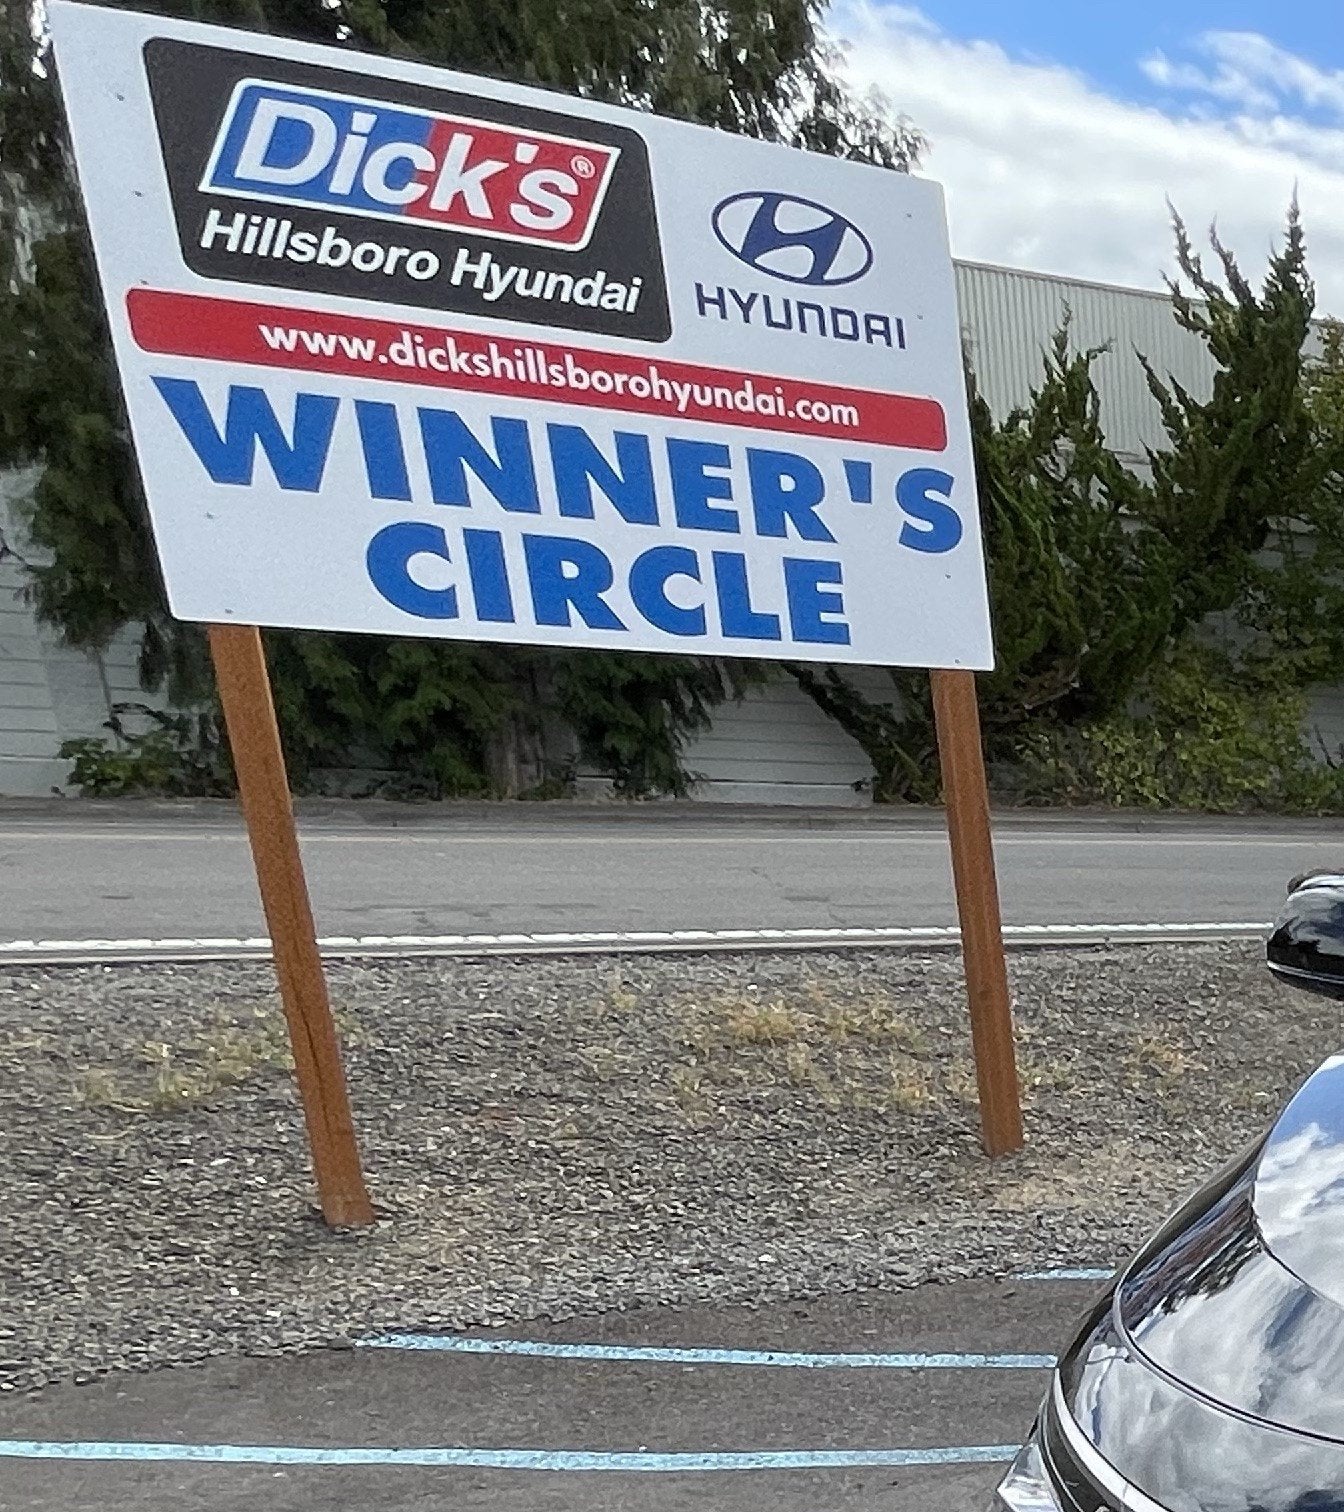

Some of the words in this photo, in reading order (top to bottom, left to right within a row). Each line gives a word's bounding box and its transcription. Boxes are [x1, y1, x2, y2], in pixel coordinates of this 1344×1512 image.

[200, 208, 440, 281] Hillsboro
[451, 247, 643, 314] Hyundai
[696, 282, 907, 350] HYUNDAI
[260, 320, 860, 429] www.dickshillsborohyundai.com
[150, 375, 964, 554] WINNER'S
[366, 521, 852, 646] CIRCLE
